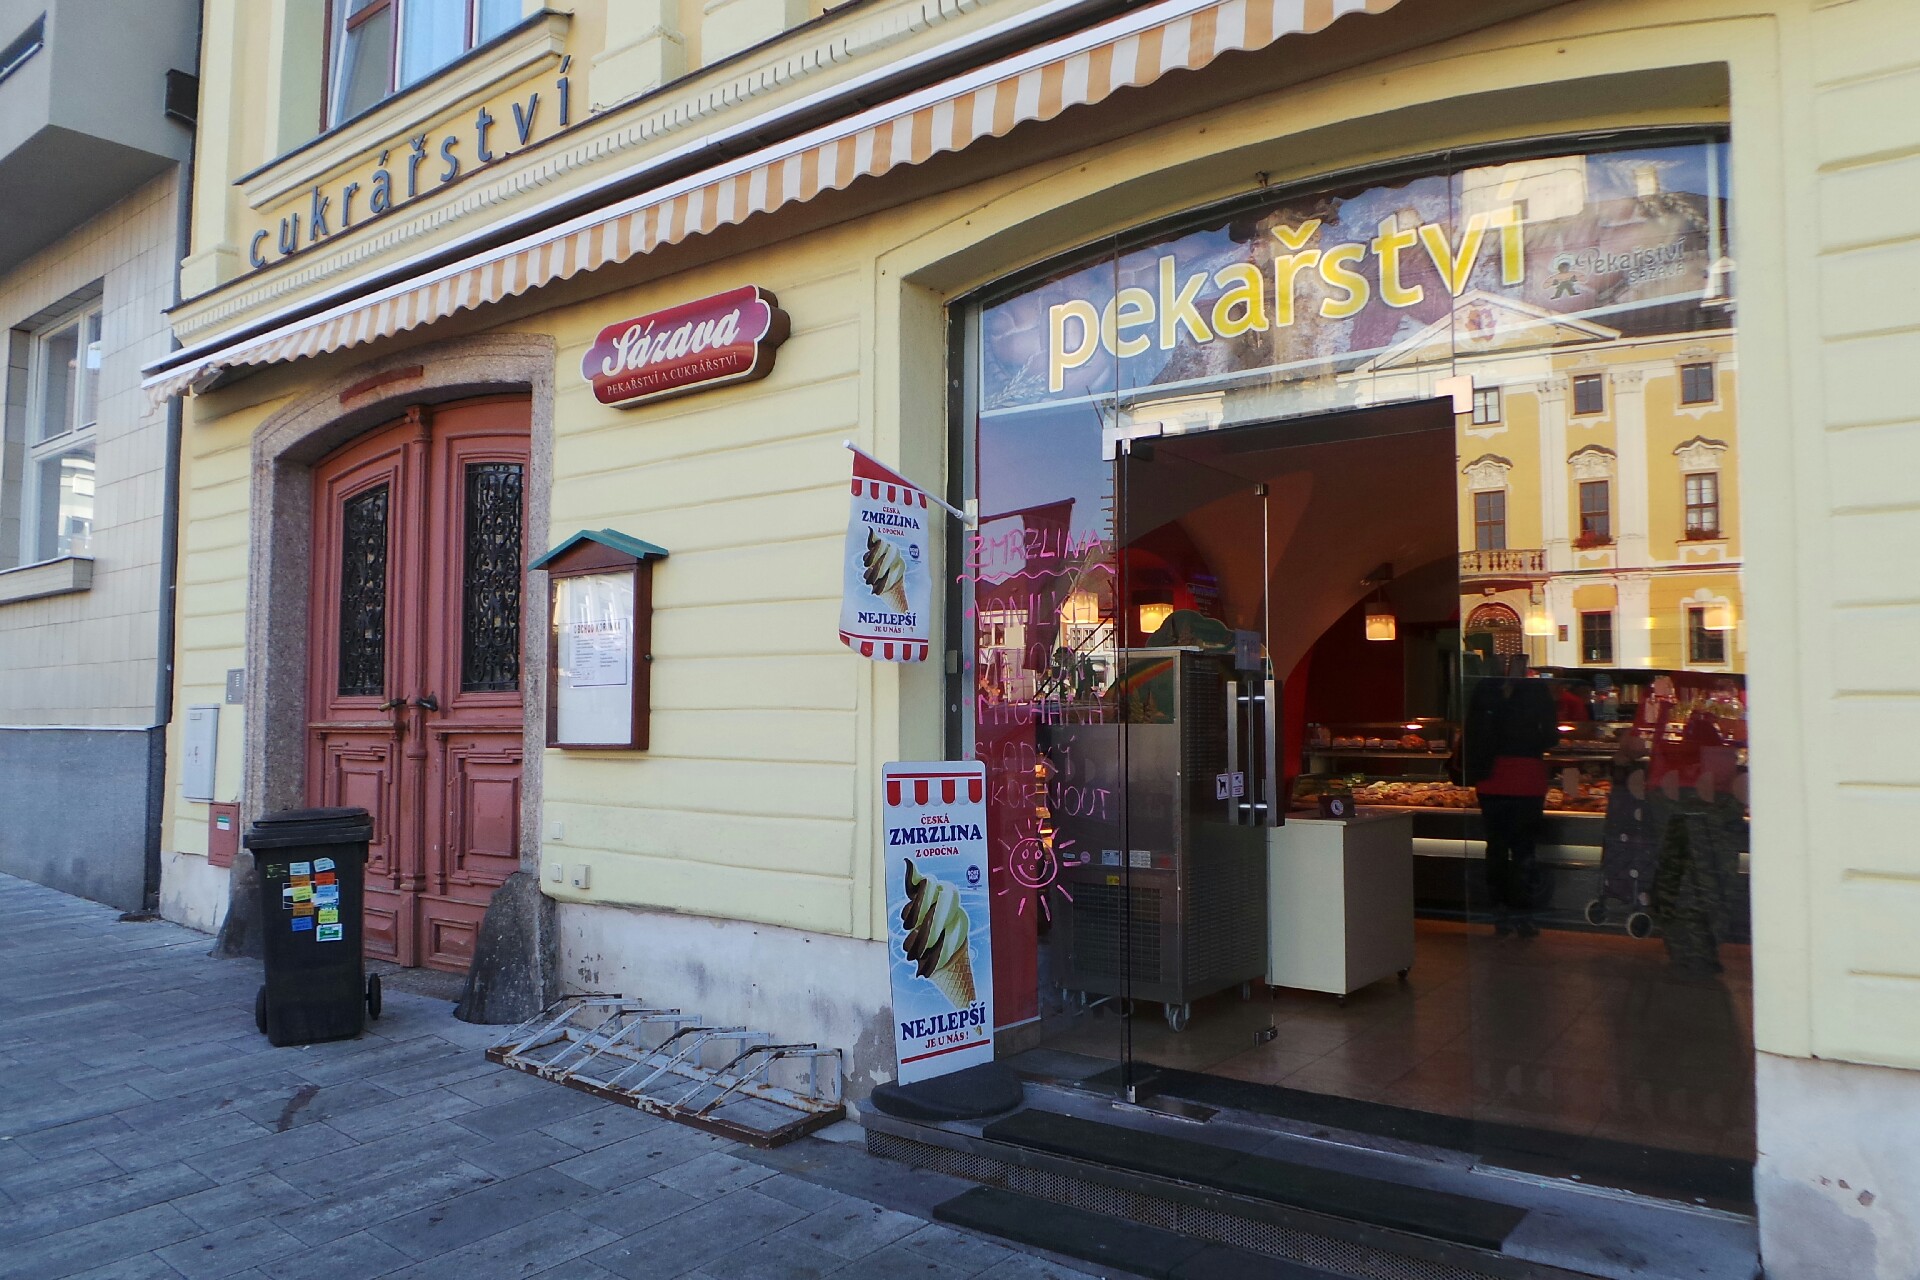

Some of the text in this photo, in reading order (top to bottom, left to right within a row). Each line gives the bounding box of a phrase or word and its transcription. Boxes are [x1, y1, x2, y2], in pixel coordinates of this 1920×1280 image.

[250, 55, 571, 268] cukrářství
[1575, 236, 1687, 281] Pekařství
[1048, 165, 1526, 394] pekařství
[602, 308, 740, 376] Sázava
[607, 352, 738, 396] PEKAŘSTVÍ A CUKRÁŘSTVÍ
[861, 510, 920, 530] ZMRZLINA
[858, 611, 917, 627] NEJLEPŠÍ
[974, 735, 1076, 776] SLADKÝ
[920, 812, 950, 825] ČESKÁ
[990, 779, 1111, 820] KORNOUT
[889, 823, 983, 846] ZMRZLINA
[915, 844, 959, 858] Z OPOČNA
[901, 1001, 986, 1041] NEJLEPŠÍ
[925, 1039, 937, 1049] JE
[938, 1036, 945, 1046] U
